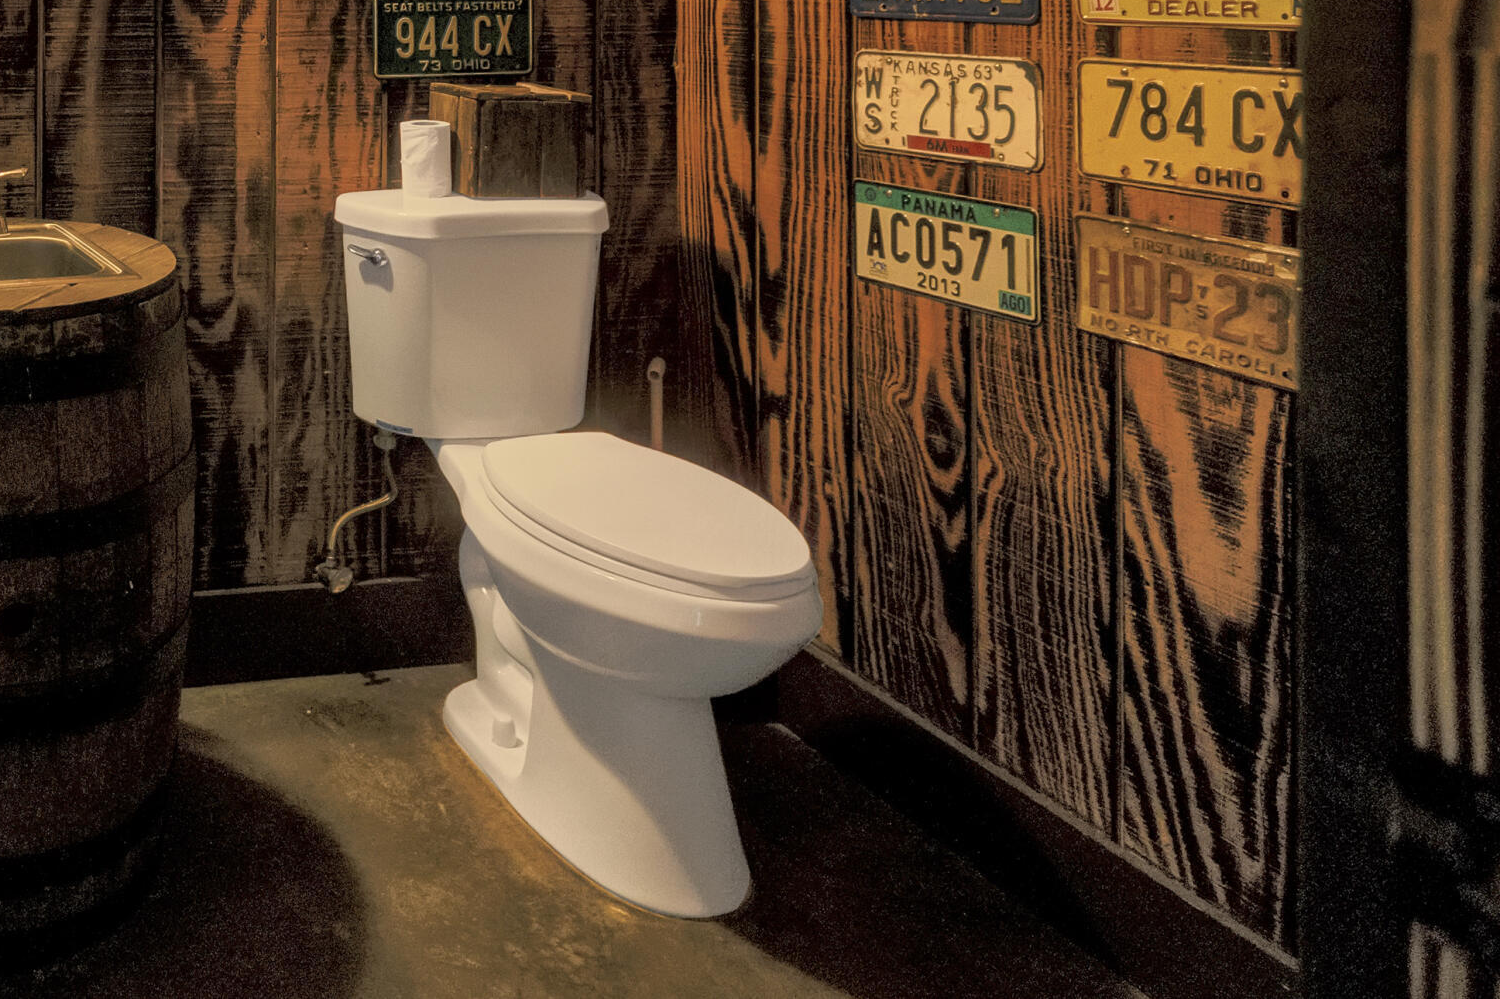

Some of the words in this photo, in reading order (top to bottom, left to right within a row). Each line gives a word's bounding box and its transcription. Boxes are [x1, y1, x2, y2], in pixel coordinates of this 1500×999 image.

[384, 3, 413, 12] SEAT
[418, 2, 452, 11] BELTS
[396, 17, 459, 58] 944
[474, 15, 513, 56] CX
[419, 60, 441, 71] 73
[452, 59, 490, 70] OHIO
[893, 59, 967, 78] KANSAS
[974, 65, 992, 80] 63
[919, 79, 1015, 144] 2135
[1107, 79, 1204, 146] 784
[1232, 87, 1304, 159] CX
[1144, 159, 1176, 180] 71
[1195, 166, 1262, 191] OHIO
[901, 195, 977, 223] PANAMA
[1133, 237, 1172, 255] FIRST
[917, 272, 960, 296] 2013
[1000, 296, 1026, 312] AGO
[1091, 314, 1169, 346] NORTH
